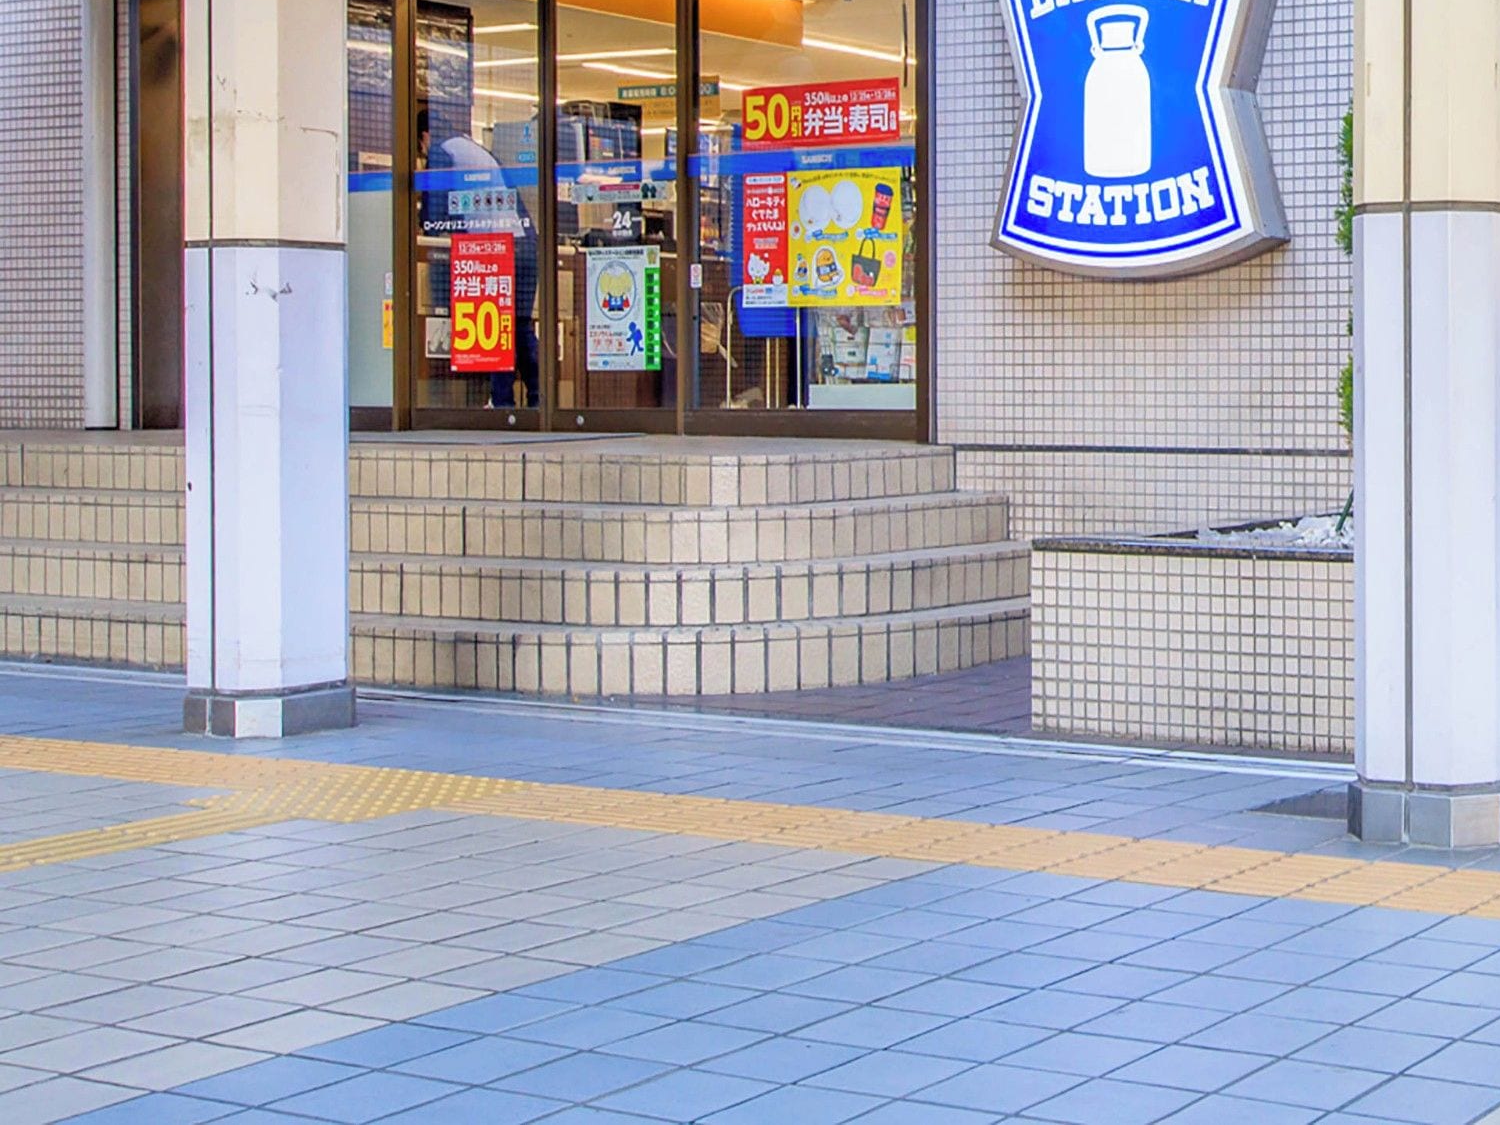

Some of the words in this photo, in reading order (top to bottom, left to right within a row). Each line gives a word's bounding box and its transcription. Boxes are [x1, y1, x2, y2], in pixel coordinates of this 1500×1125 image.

[745, 93, 789, 141] 50
[804, 103, 889, 137] 弁当・寿司
[1027, 166, 1216, 226] STATION
[612, 211, 632, 230] 24
[453, 276, 512, 297] 弁当・寿司
[453, 300, 500, 352] 50
